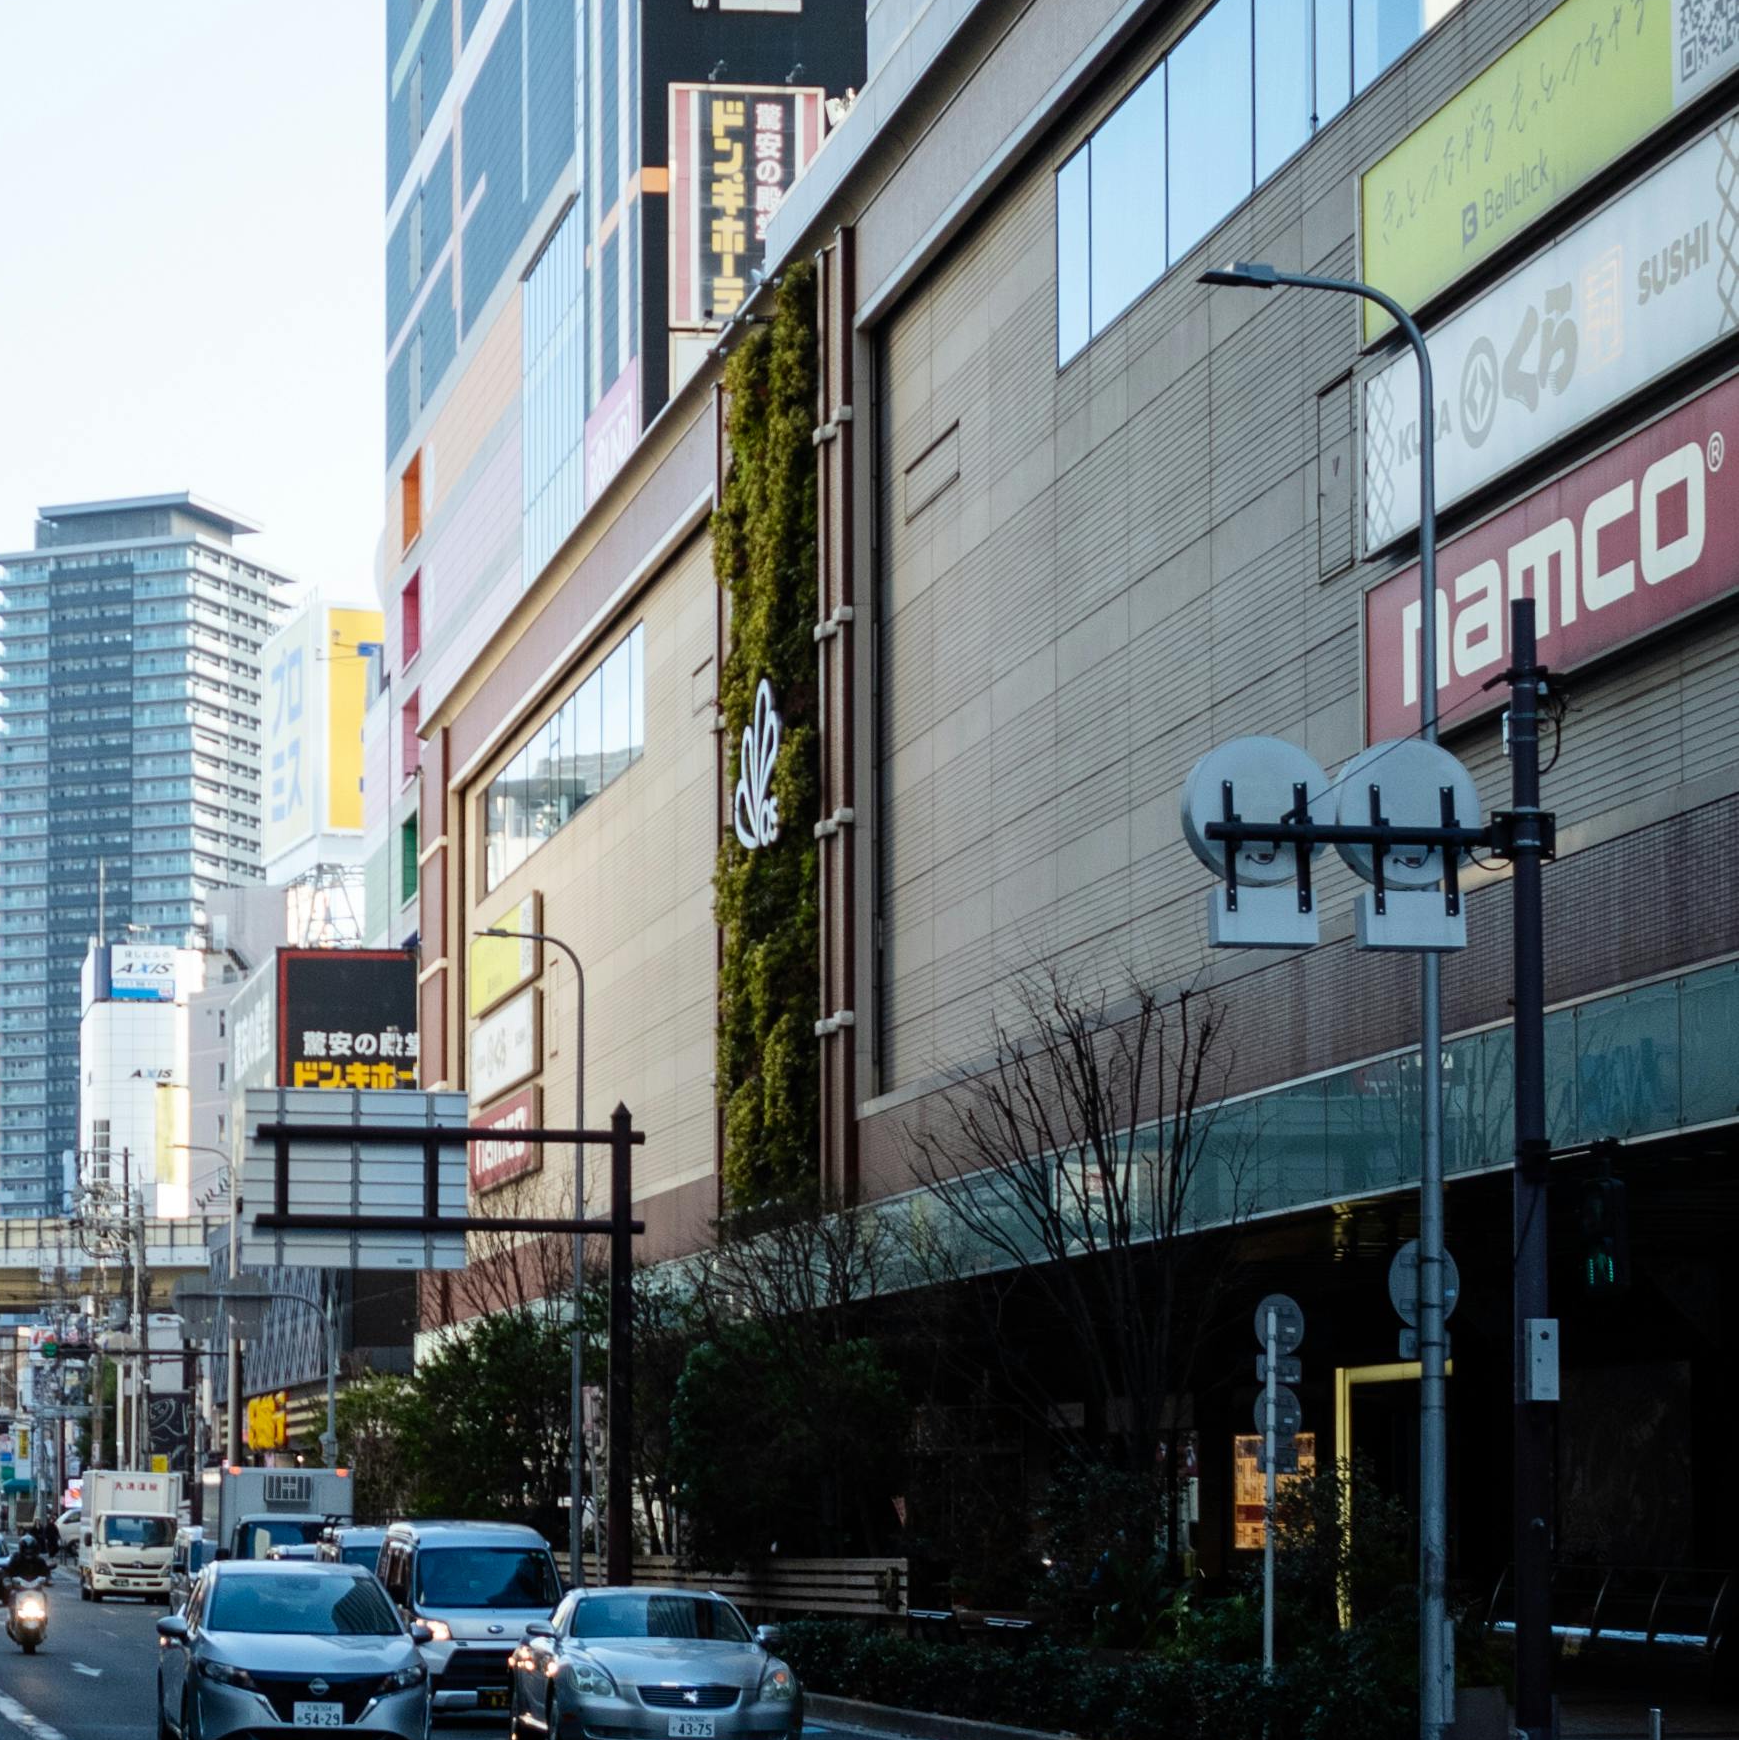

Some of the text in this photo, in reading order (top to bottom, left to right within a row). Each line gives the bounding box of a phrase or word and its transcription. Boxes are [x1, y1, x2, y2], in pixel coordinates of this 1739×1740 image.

[1636, 220, 1709, 307] SUSHI
[1501, 281, 1578, 413] くら
[1402, 441, 1706, 707] namco
[115, 963, 175, 975] AXIS
[130, 1068, 173, 1079] AXIS
[678, 1723, 713, 1736] 43-75
